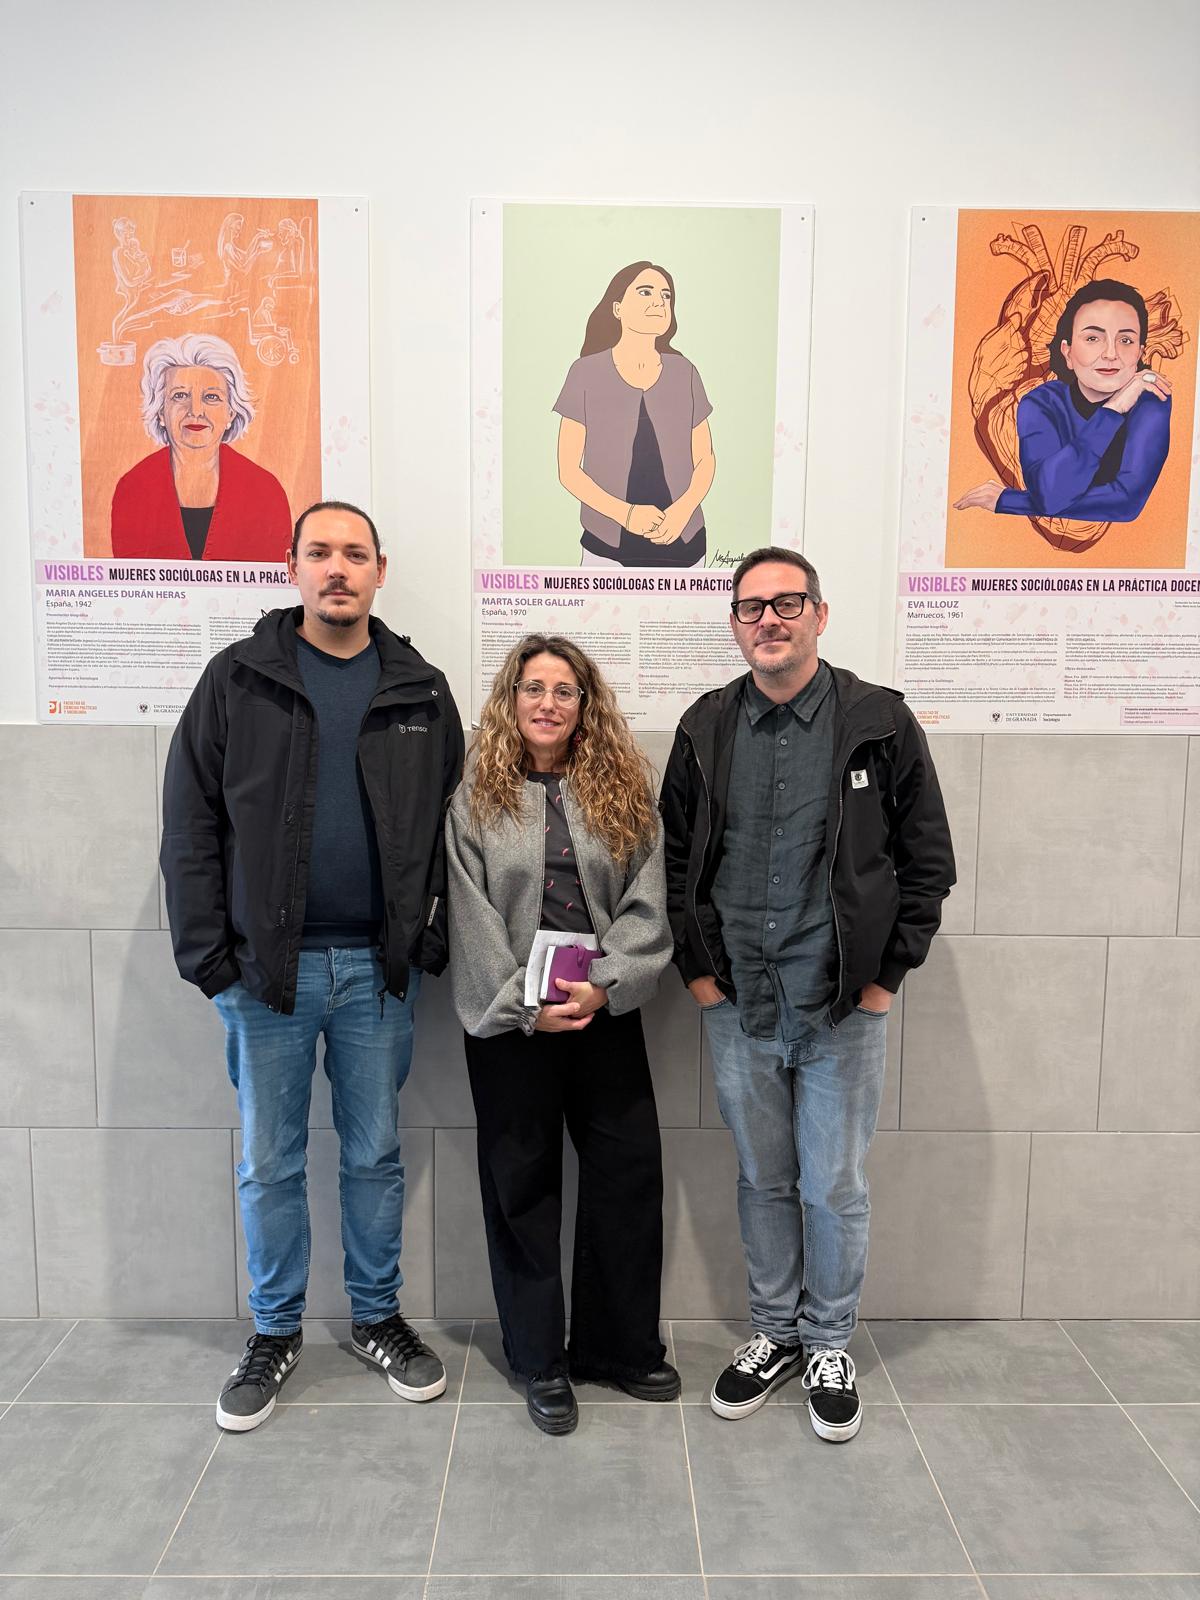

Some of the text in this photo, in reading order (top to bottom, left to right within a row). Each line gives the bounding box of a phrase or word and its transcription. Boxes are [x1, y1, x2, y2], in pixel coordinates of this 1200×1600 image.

[44, 564, 291, 584] VISIBLES MUJERES SOCIÓLOGAS EN LA PRÁCT
[481, 573, 733, 591] VISIBLES MUJERES SOCIÓLOGAS EN LA PRÁCTIC
[908, 576, 967, 592] VISIBLES
[971, 578, 1018, 591] MUJERES
[1020, 577, 1083, 592] SOCIÓLOGAS
[1086, 579, 1100, 592] EN
[1102, 579, 1115, 592] LA
[1118, 577, 1168, 592] PRÁCTICA
[45, 588, 186, 599] MARIA ANGELES DURÁN HERAS
[46, 599, 92, 609] España, 1942
[481, 597, 585, 607] MARTA SOLER GALLART
[907, 600, 959, 609] EVA ILLOUZ
[481, 608, 527, 616] España, 1970
[907, 611, 964, 620] Marruecos, 1961
